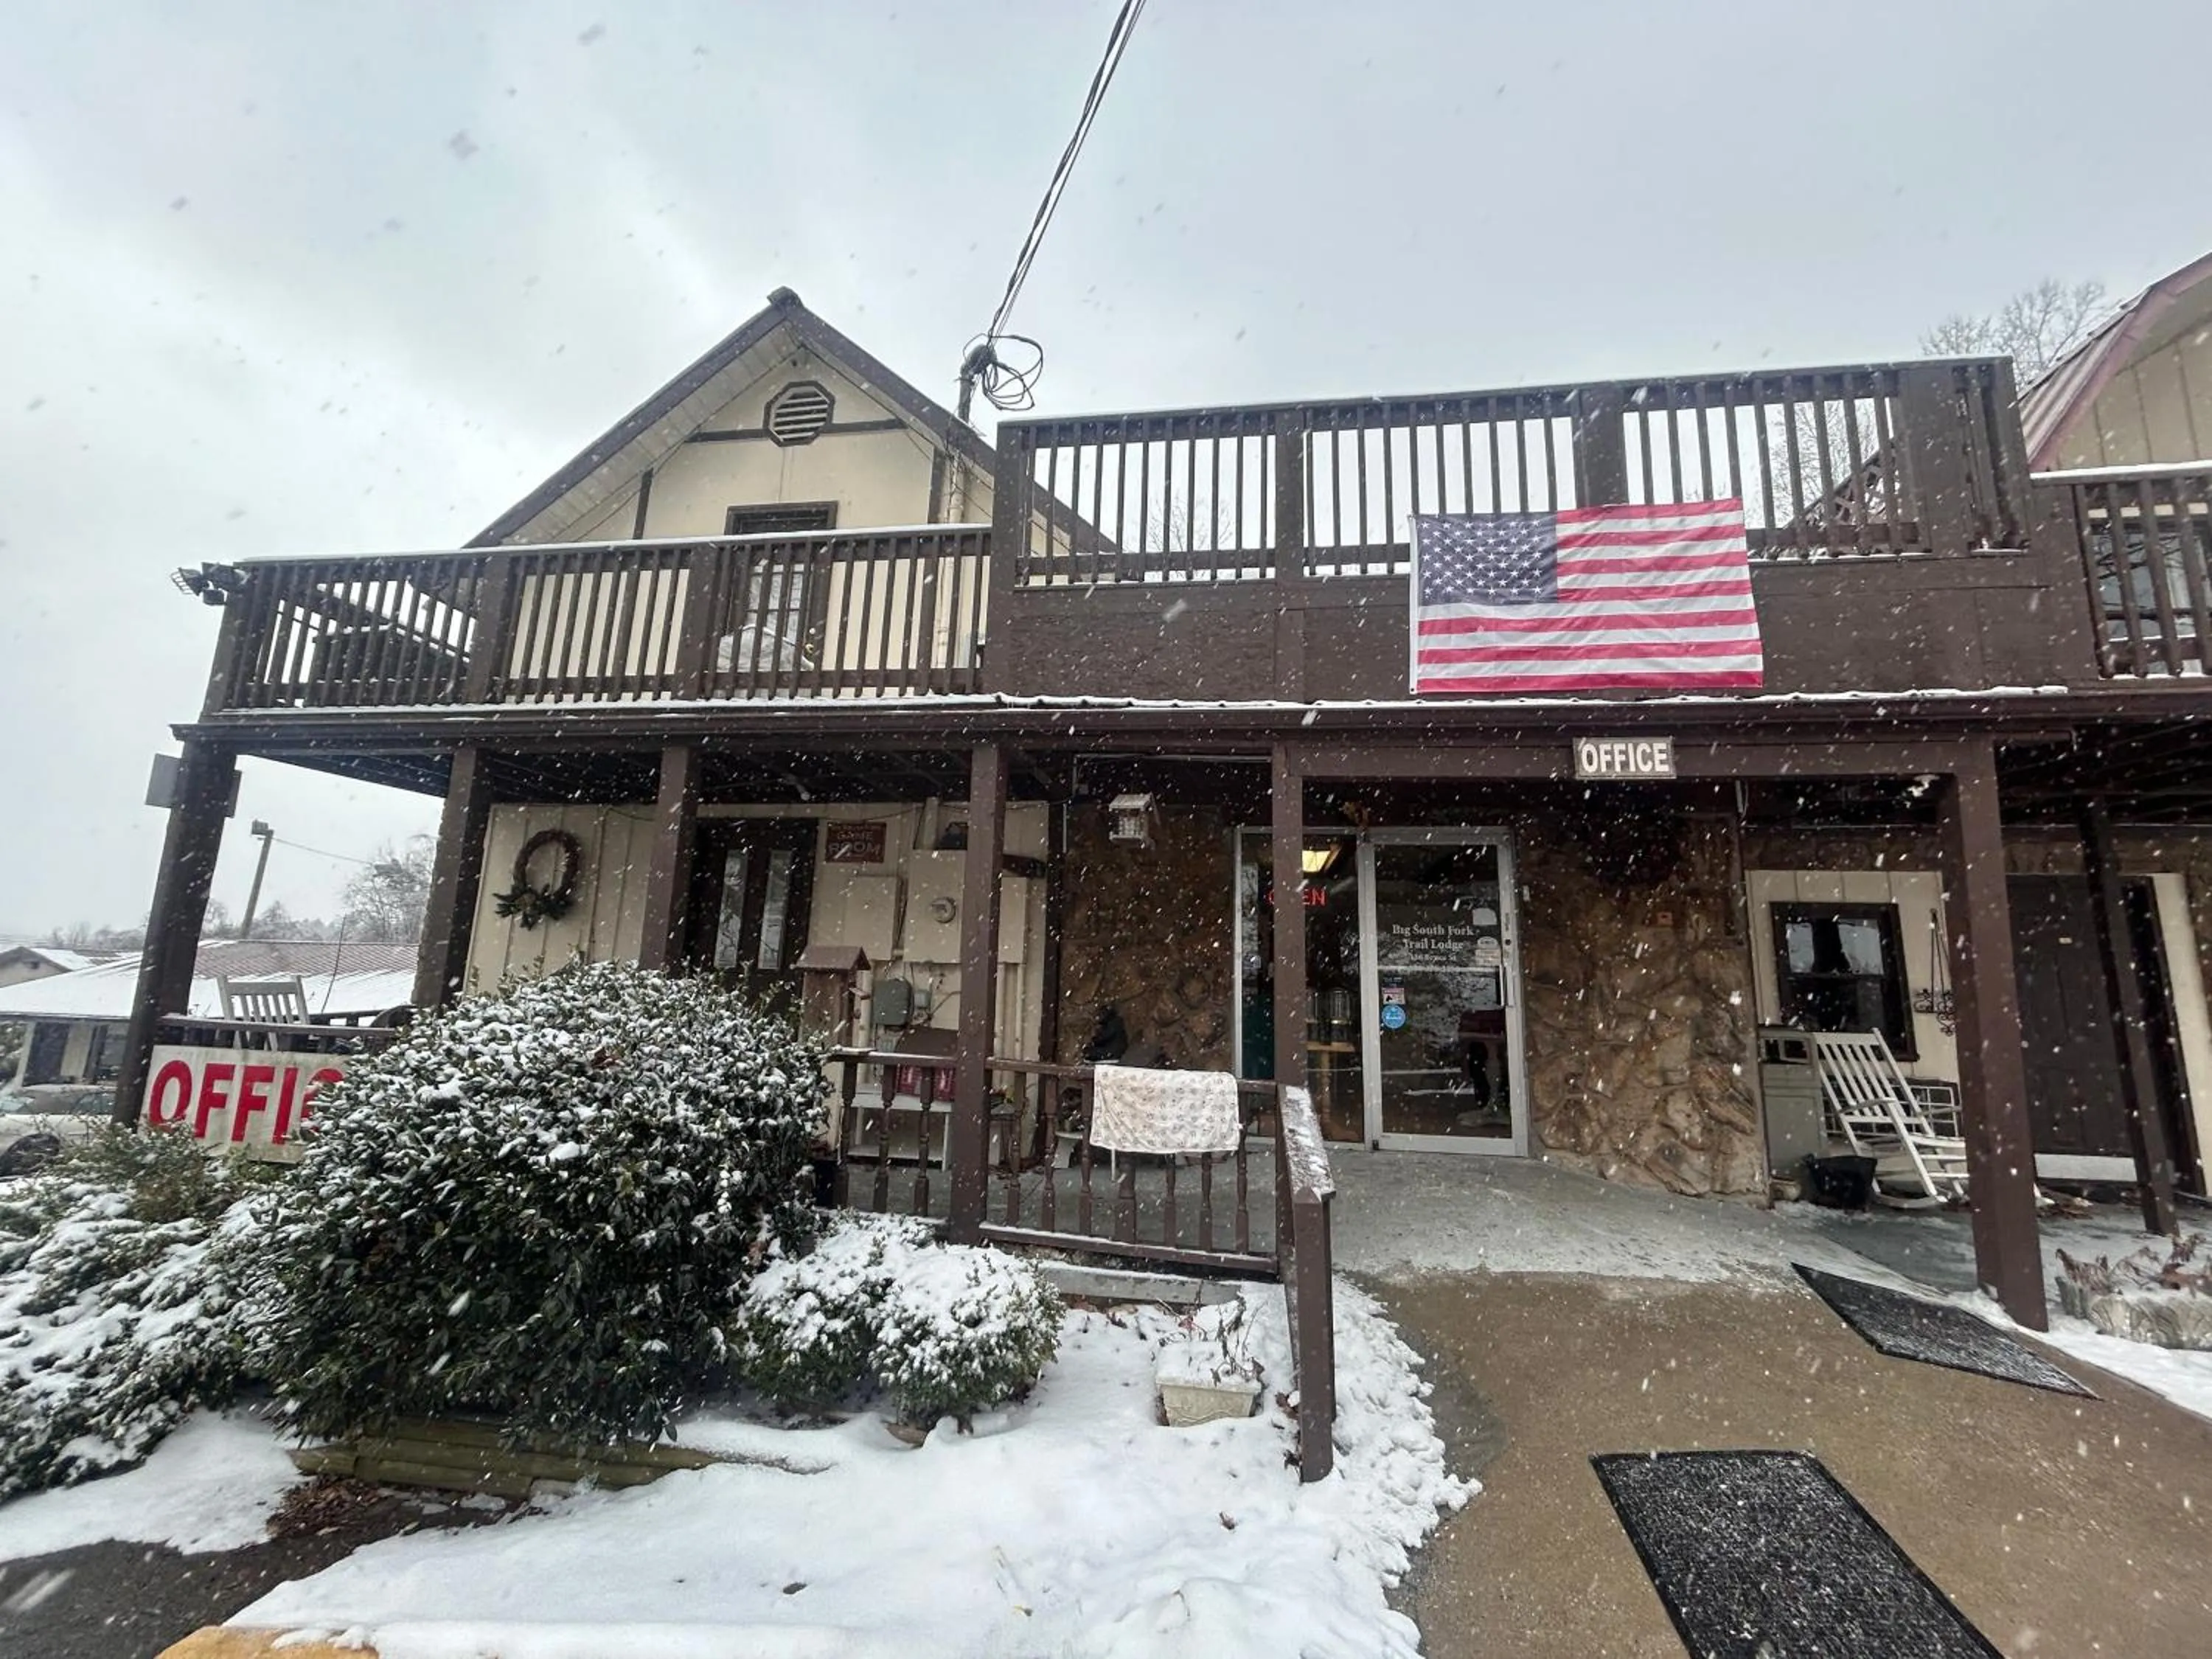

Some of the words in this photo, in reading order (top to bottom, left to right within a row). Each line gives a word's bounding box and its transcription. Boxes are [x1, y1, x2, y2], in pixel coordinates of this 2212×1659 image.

[1581, 742, 1670, 773] OFFICE
[838, 831, 873, 841] GAME
[829, 841, 882, 855] ROOM
[1392, 924, 1411, 936] Big
[1413, 923, 1444, 935] South
[1447, 924, 1475, 936] Fork
[1402, 938, 1428, 949] Trail
[1430, 938, 1464, 951] Lodge
